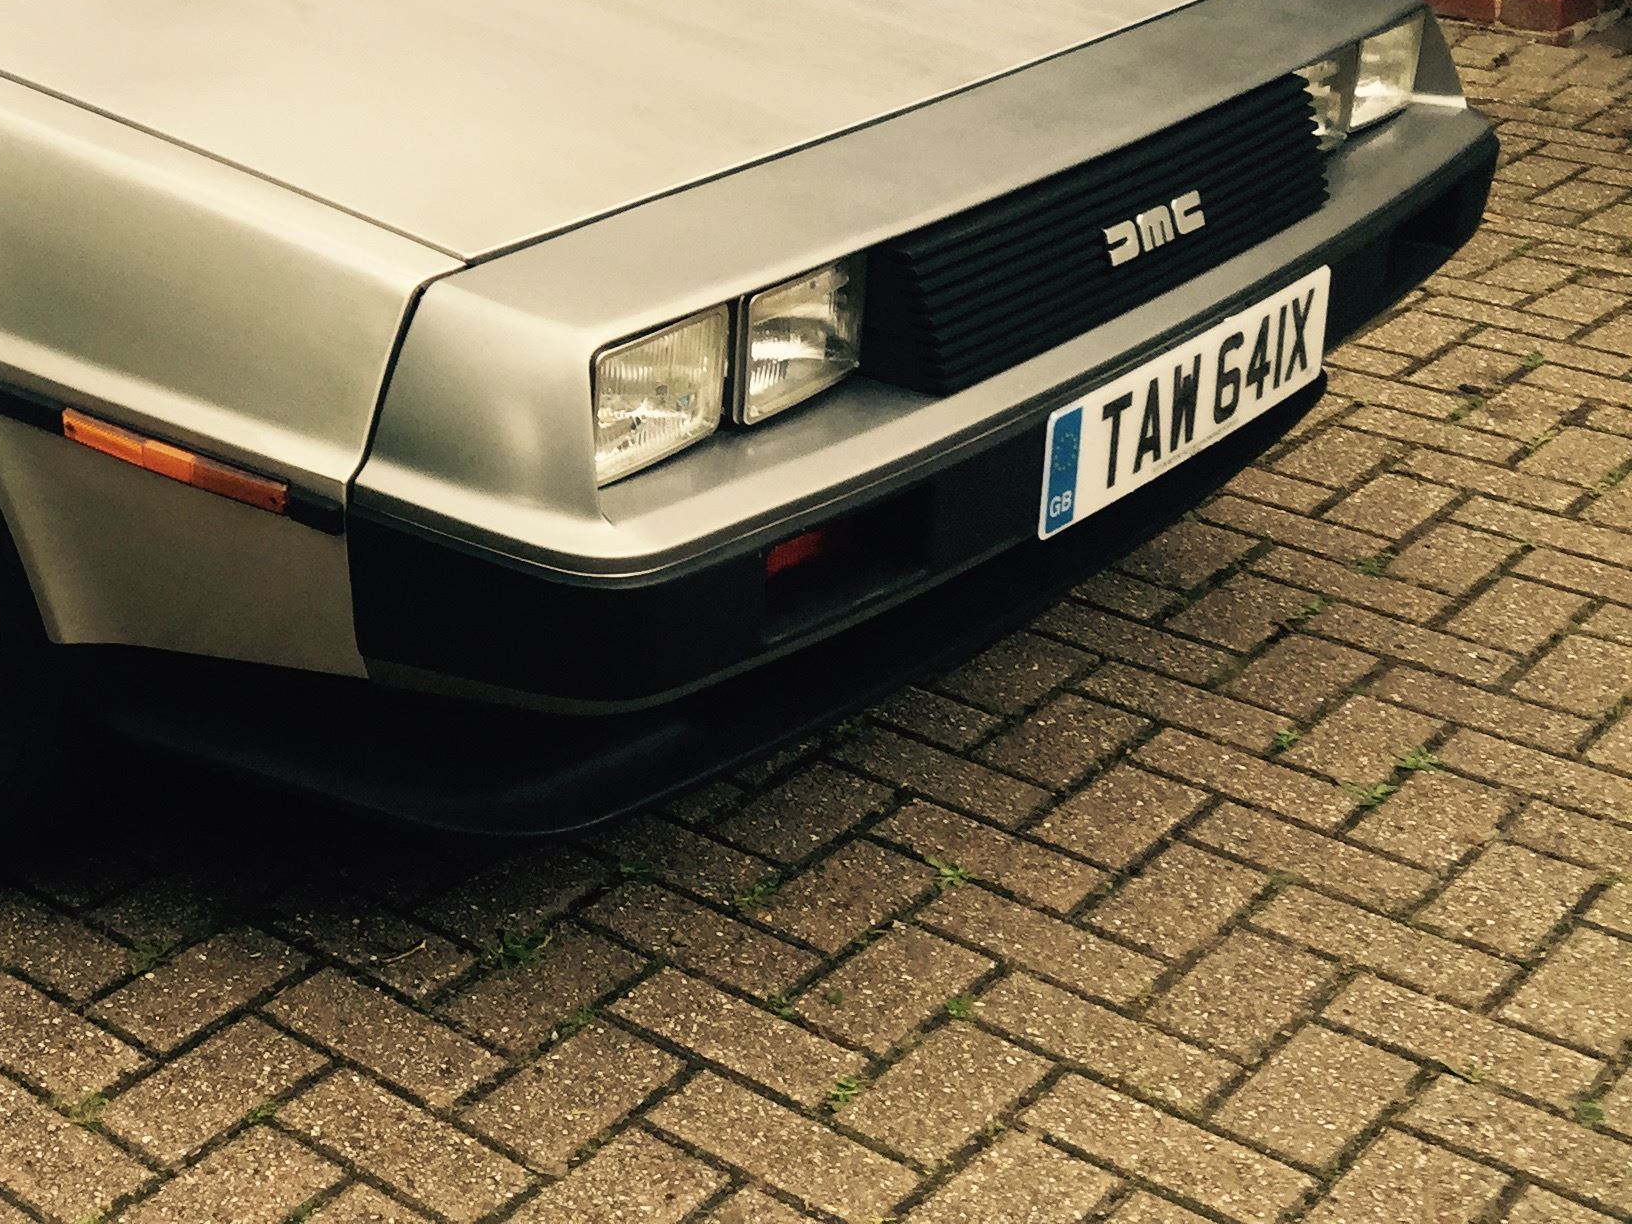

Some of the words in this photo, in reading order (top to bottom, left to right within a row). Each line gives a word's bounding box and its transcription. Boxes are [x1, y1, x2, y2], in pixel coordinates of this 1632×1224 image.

[1102, 190, 1206, 266] DMC
[1102, 353, 1202, 489] TAW
[1214, 288, 1316, 425] 641X
[1049, 490, 1073, 518] GB
